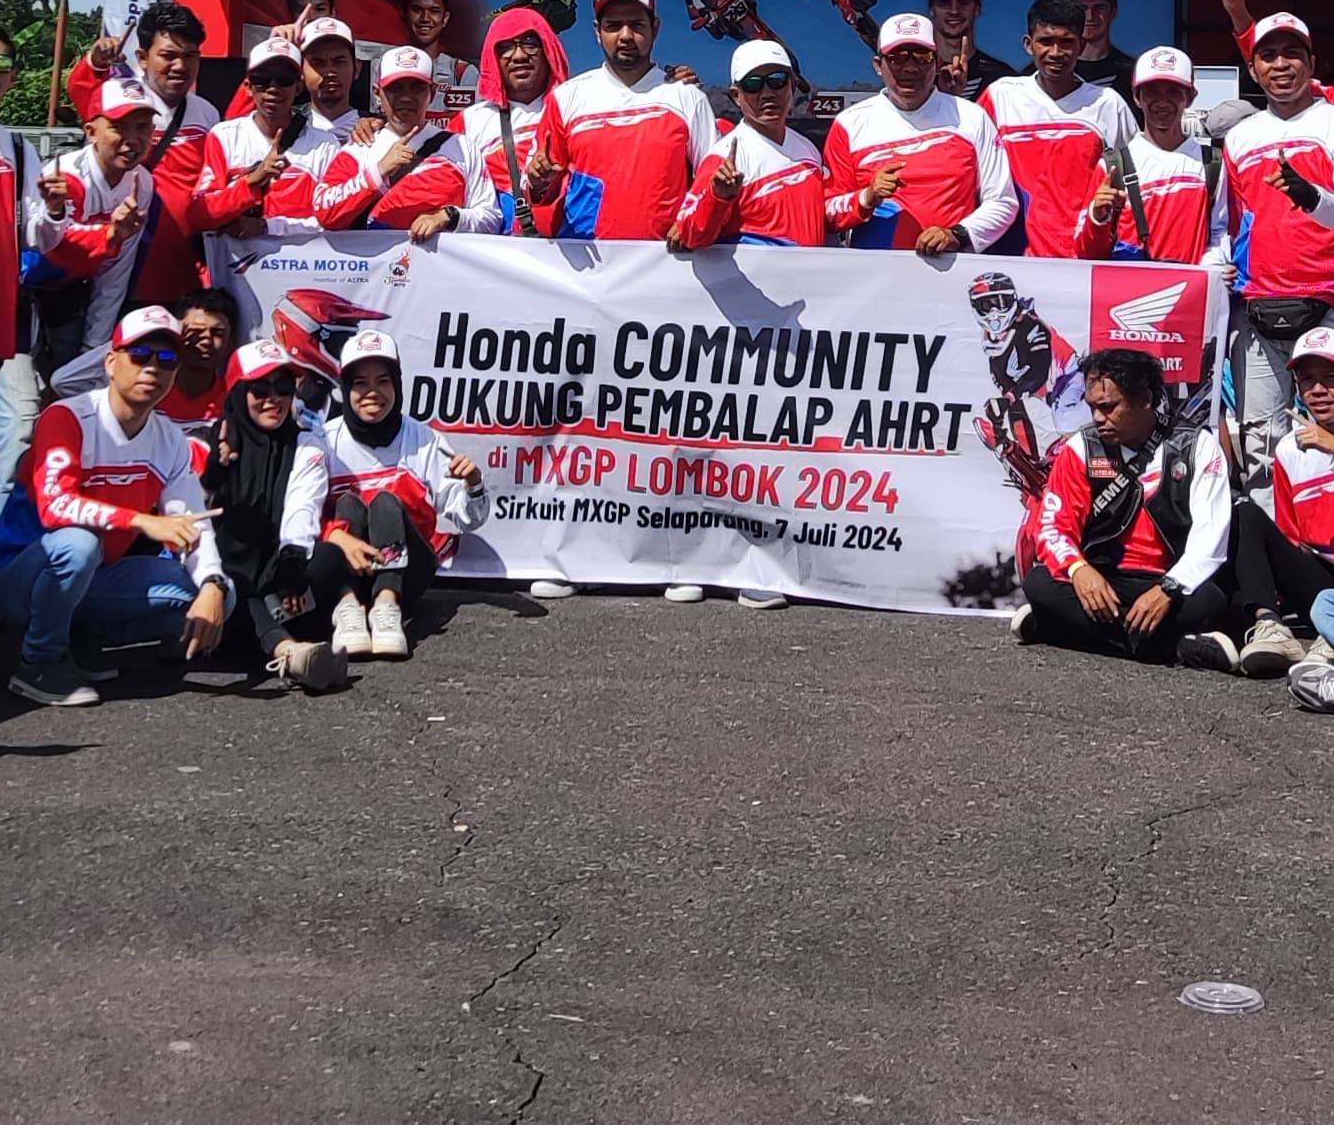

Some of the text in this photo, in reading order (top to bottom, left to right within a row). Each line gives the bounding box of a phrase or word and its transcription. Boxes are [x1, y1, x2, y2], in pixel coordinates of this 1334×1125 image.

[447, 93, 472, 104] 325
[813, 100, 841, 111] 243
[260, 259, 370, 272] ASTRA MOTOR
[1108, 329, 1186, 343] HONDA
[434, 311, 946, 393] Honda COMMUNITY
[1161, 356, 1184, 372] ART.
[409, 375, 972, 452] DUKUNG PEMBALAP AHRT
[488, 445, 900, 514] di MXGP LOMBOK 2024
[495, 496, 904, 552] Sirkuit MXGP Selaparang, 7 Juli 2024
